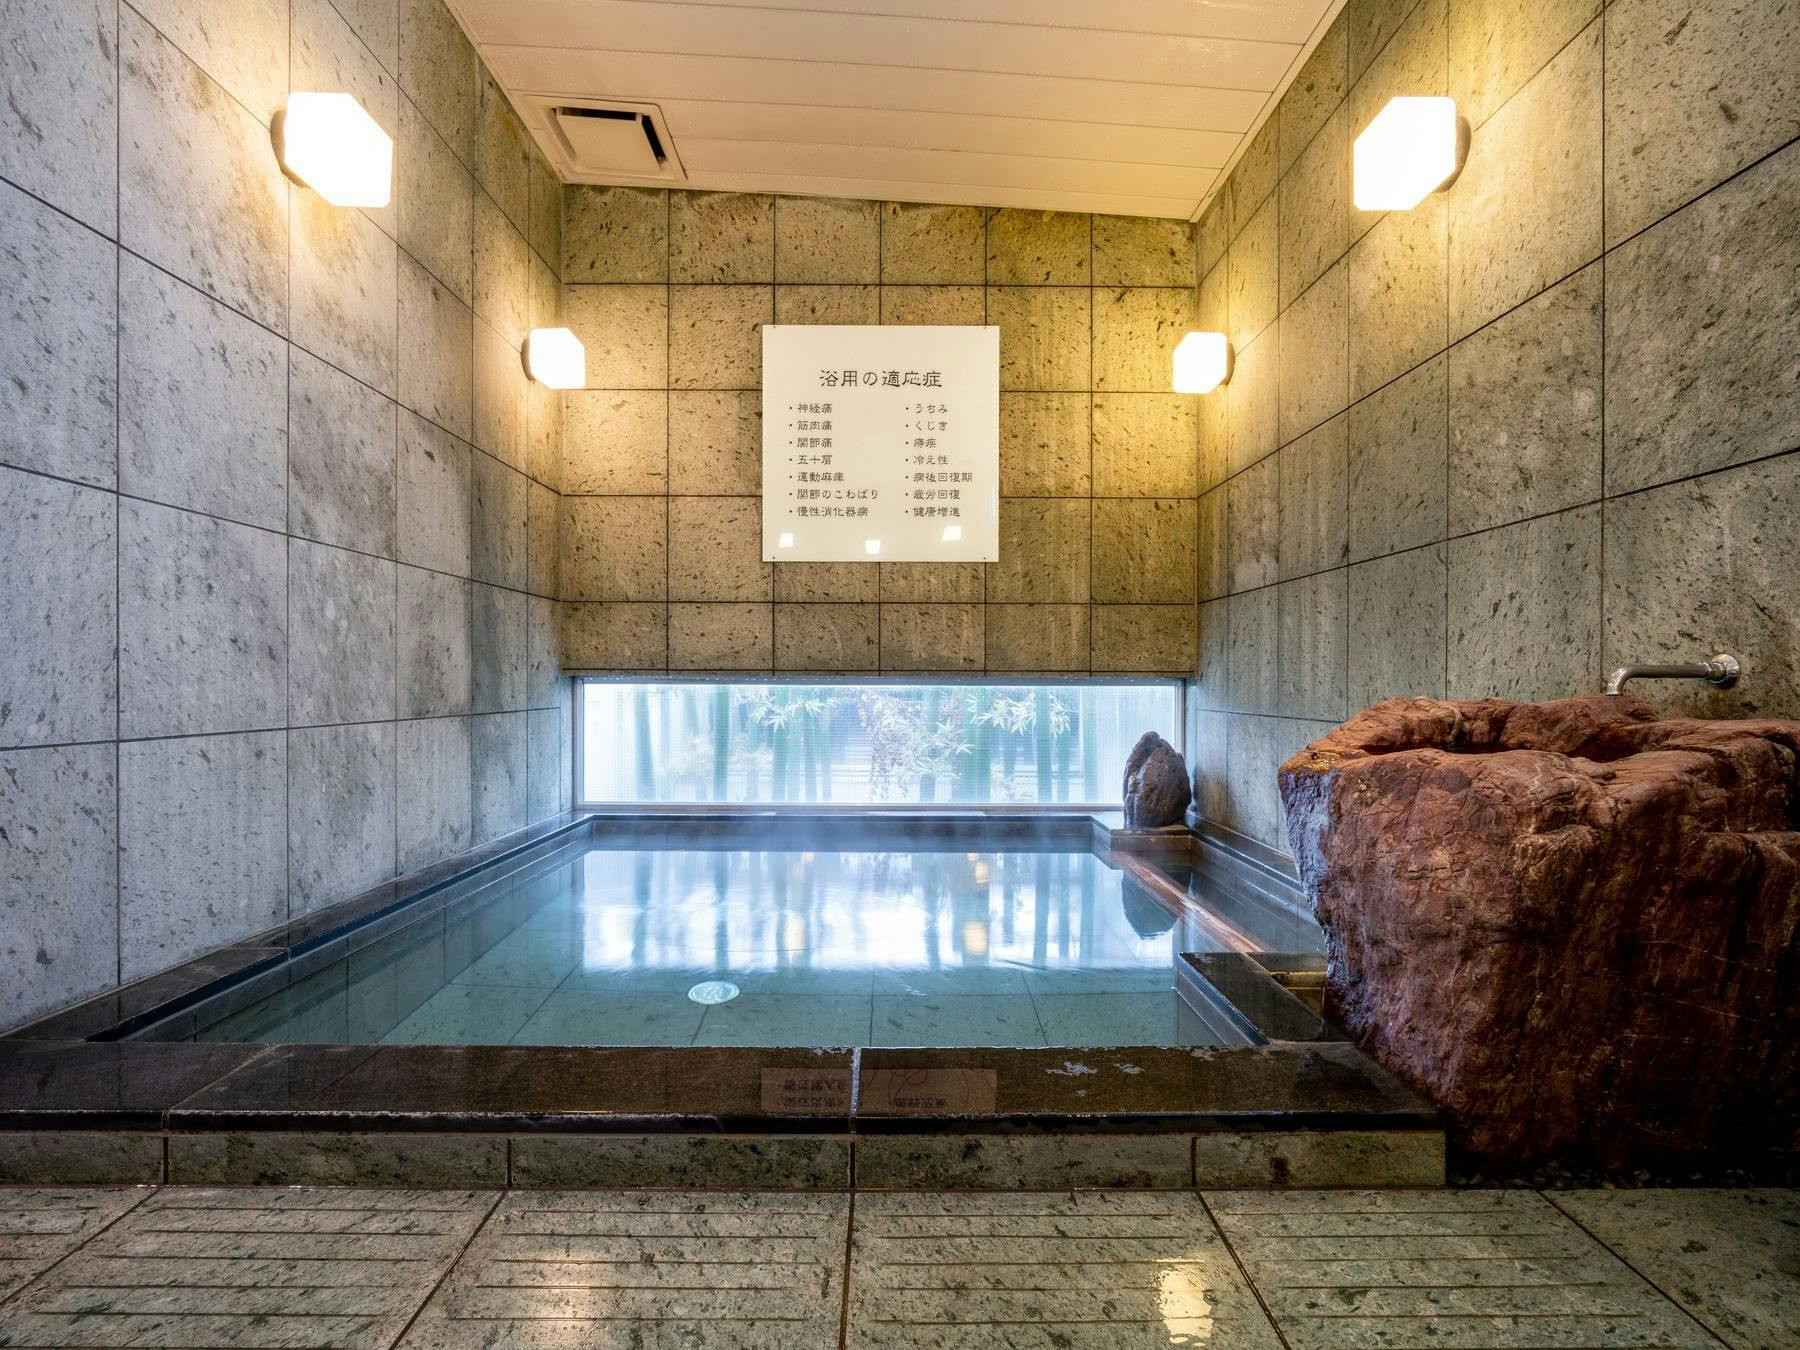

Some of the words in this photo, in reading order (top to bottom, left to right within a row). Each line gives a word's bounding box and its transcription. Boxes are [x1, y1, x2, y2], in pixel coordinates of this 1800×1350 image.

[819, 369, 942, 388] 浴用の適応症
[797, 403, 832, 414] 神経痛
[915, 403, 948, 414] うちみ
[797, 420, 832, 431] 筋肉痛
[915, 420, 948, 431] くじき
[796, 437, 832, 448] 関節痛
[797, 455, 832, 465] 五十肩
[913, 455, 949, 465] 冷え性
[797, 472, 844, 483] 運動麻痺
[913, 472, 973, 483] 病後回復期
[796, 489, 878, 500] 関節のこわばり
[913, 489, 960, 500] 疲労回復
[797, 506, 868, 517] 慢性消化器病
[913, 506, 960, 517] 健康増進
